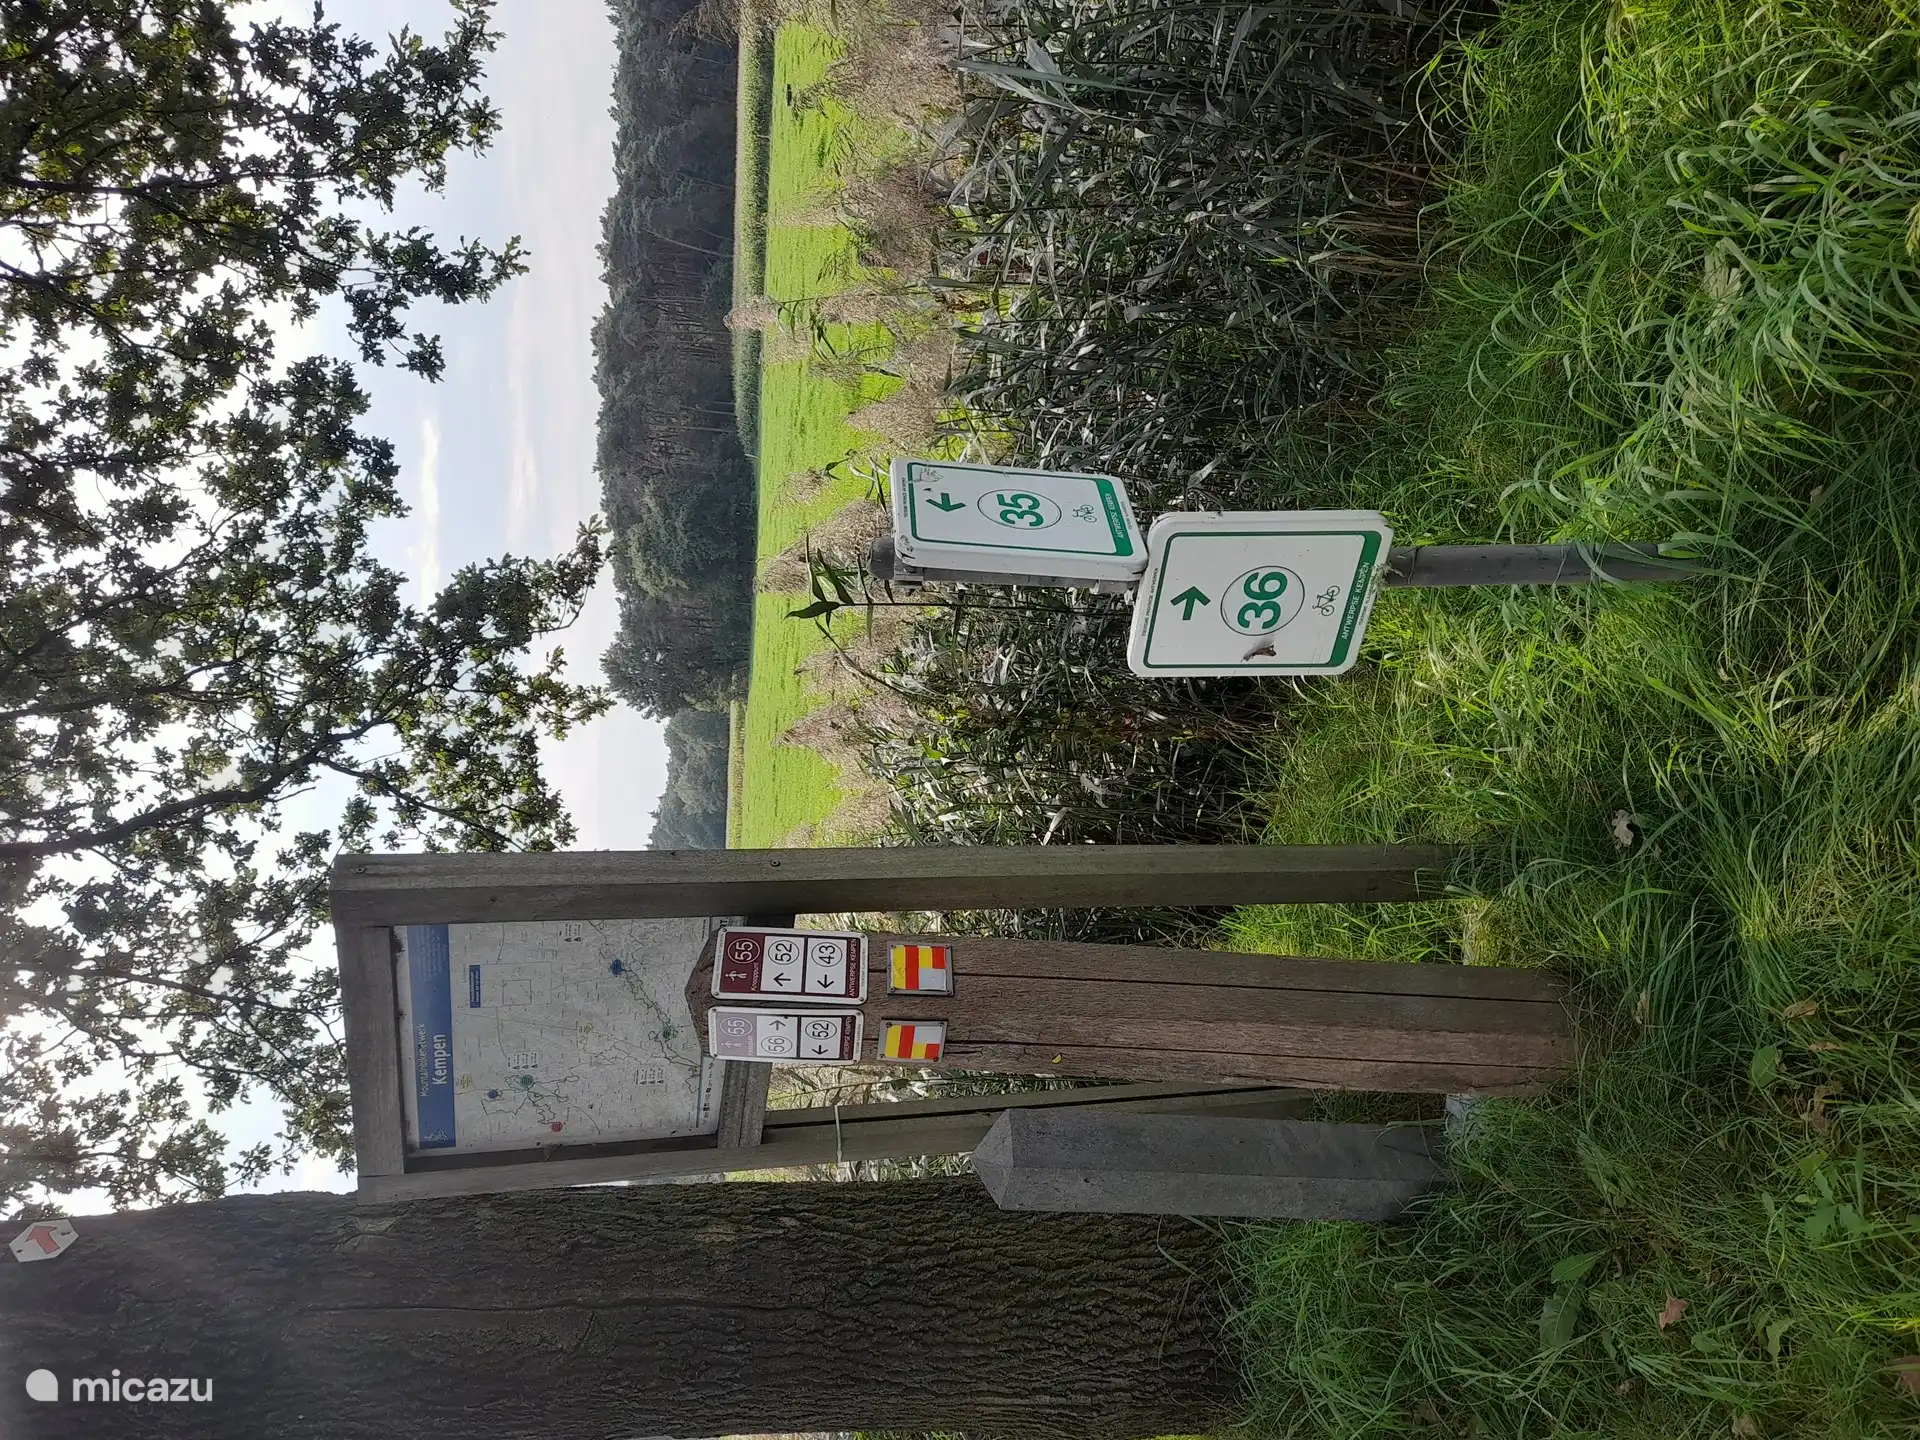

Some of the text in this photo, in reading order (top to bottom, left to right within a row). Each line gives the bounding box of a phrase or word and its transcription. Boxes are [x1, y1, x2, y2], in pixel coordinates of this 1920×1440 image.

[996, 493, 1044, 526] 35
[1104, 492, 1125, 539] ANTWERPSE KEMPEN
[1237, 571, 1288, 630] 36
[1340, 595, 1360, 640] ANTWERPSE
[1354, 562, 1370, 593] KEMPEN
[735, 941, 752, 960] 55
[775, 942, 792, 962] 52
[818, 944, 836, 964] 43
[750, 962, 760, 992] Knooppunt
[728, 1020, 745, 1034] 55
[812, 1022, 829, 1038] 52
[844, 1016, 852, 1035] KEMPEN
[768, 1038, 785, 1052] 56
[415, 1023, 429, 1097] Mountainbikenetwerk
[432, 1034, 450, 1084] Kempen
